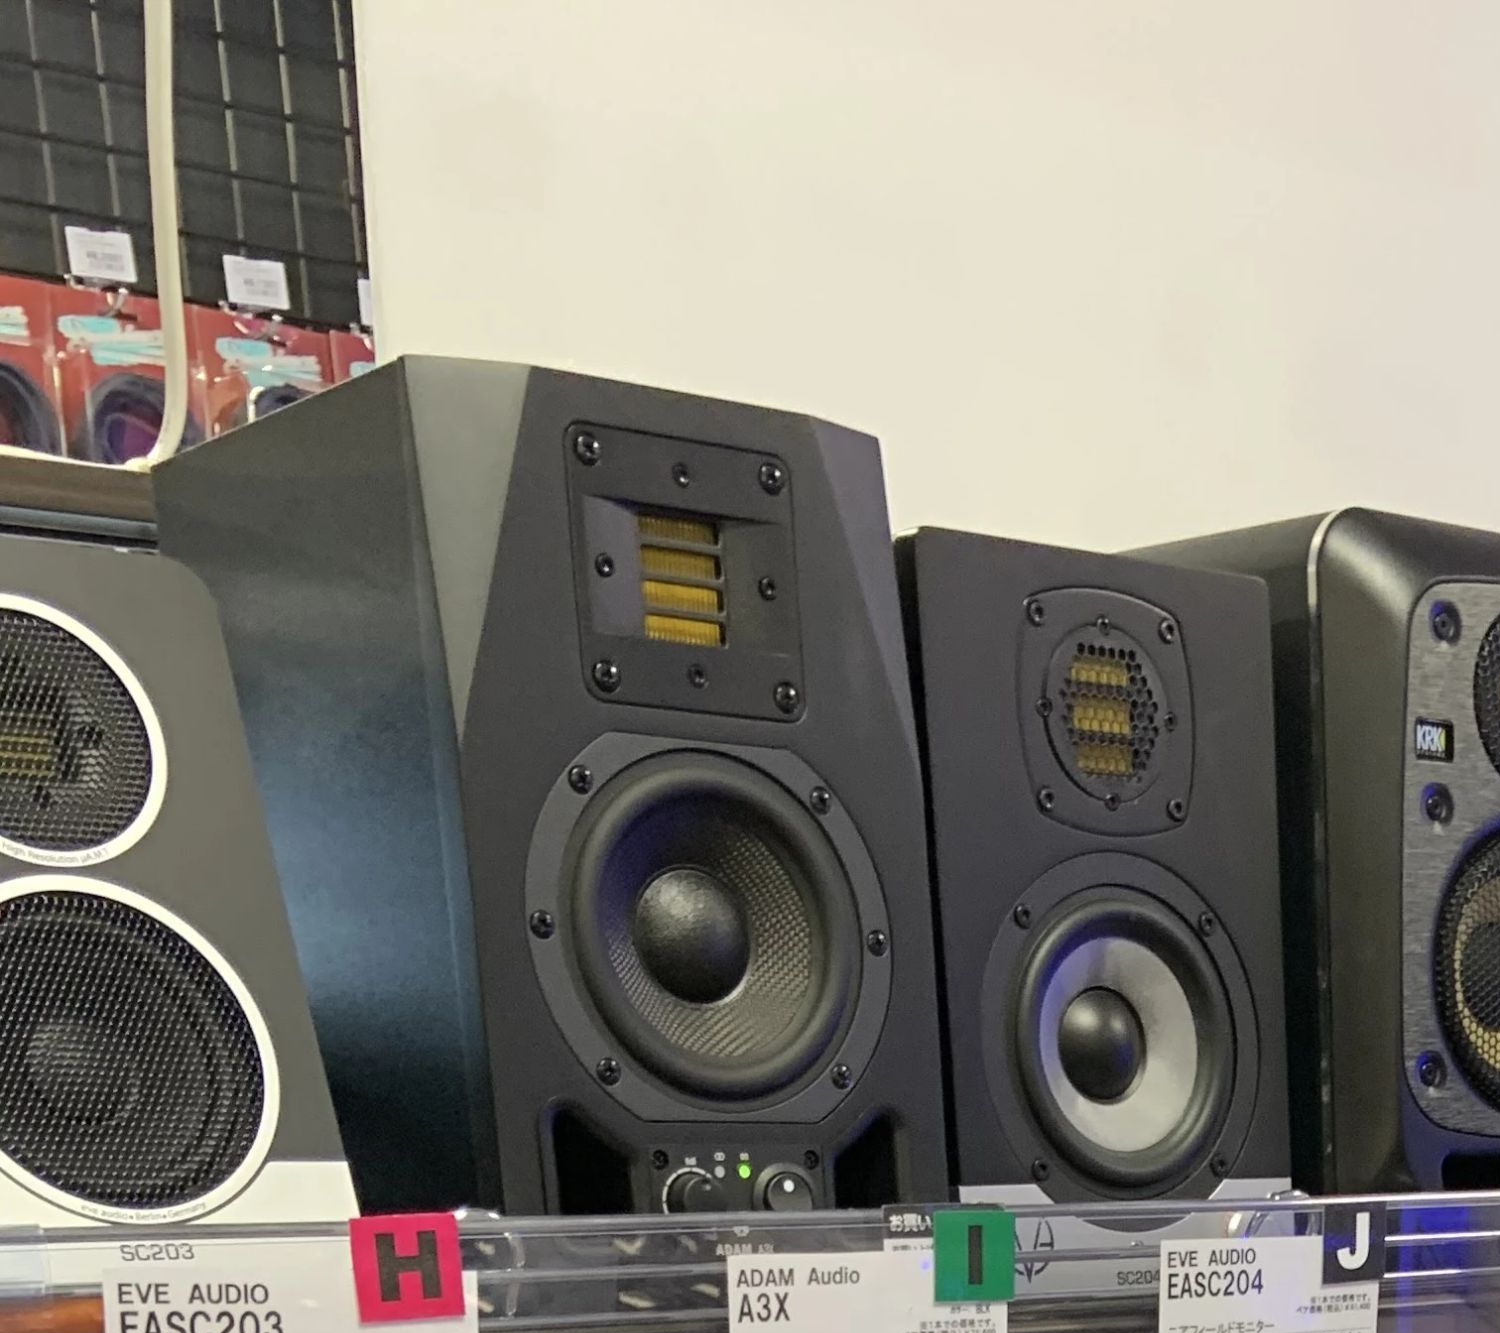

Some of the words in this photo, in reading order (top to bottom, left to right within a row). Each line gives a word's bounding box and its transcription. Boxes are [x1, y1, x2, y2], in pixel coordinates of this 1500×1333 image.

[1416, 724, 1442, 752] KRK
[120, 1243, 195, 1261] SC203
[967, 1225, 983, 1285] I
[1336, 1212, 1370, 1271] J
[375, 1230, 442, 1301] H
[1167, 1251, 1198, 1269] EVE
[1208, 1248, 1256, 1267] AUDIO
[736, 1268, 794, 1288] ADAM
[807, 1267, 860, 1286] Audio
[1167, 1269, 1264, 1299] EASC204
[118, 1283, 170, 1305] EVE
[188, 1283, 269, 1305] AUDIO
[738, 1292, 791, 1323] A3X
